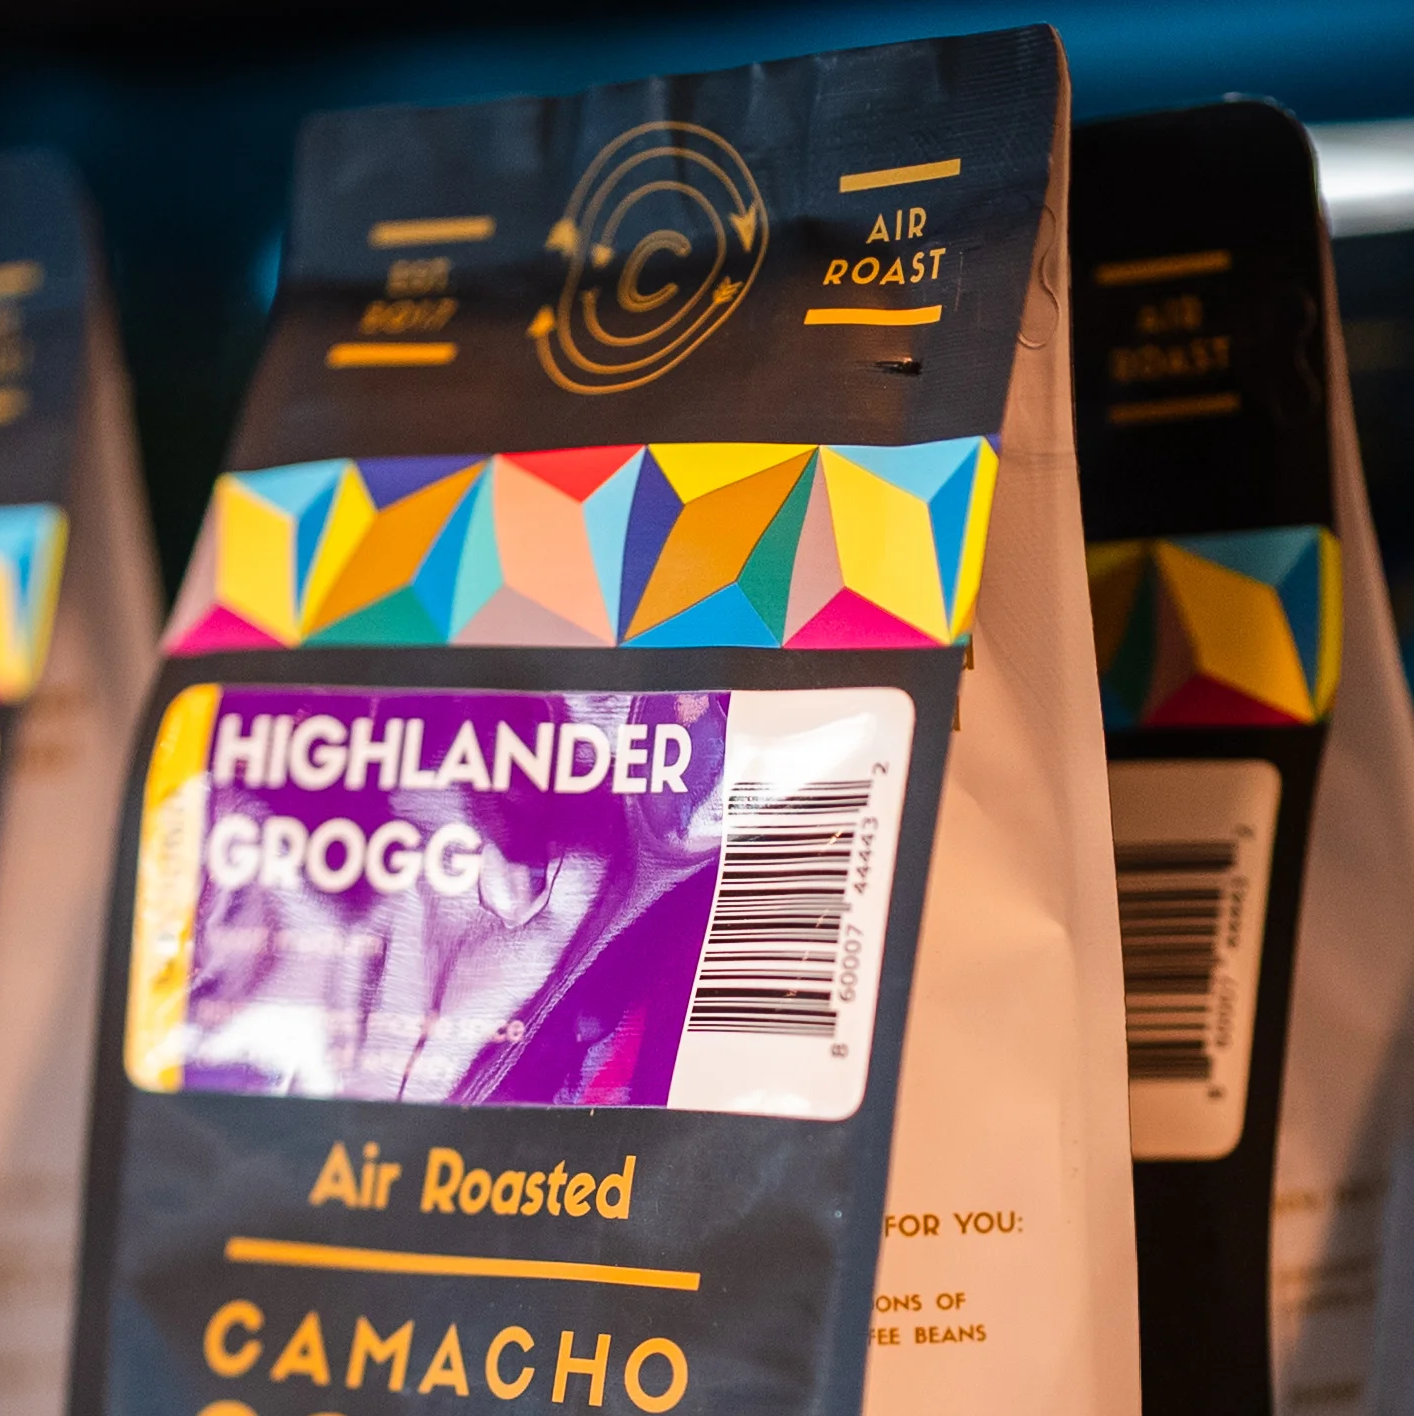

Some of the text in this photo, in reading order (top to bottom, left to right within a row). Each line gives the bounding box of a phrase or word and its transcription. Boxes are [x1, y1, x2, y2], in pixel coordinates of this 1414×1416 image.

[866, 207, 927, 244] AIR
[823, 248, 946, 287] ROAST
[214, 713, 692, 794] HIGHLANDER
[207, 814, 483, 896] GROGG
[839, 923, 864, 1003] 60007
[853, 816, 879, 895] 44443
[872, 761, 889, 776] 2
[309, 1141, 636, 1220] Air Roasted
[884, 1210, 1023, 1237] FOR YOU:
[871, 1292, 966, 1313] ONS OF
[203, 1300, 688, 1413] CAMACHO
[914, 1324, 987, 1344] BEANS
